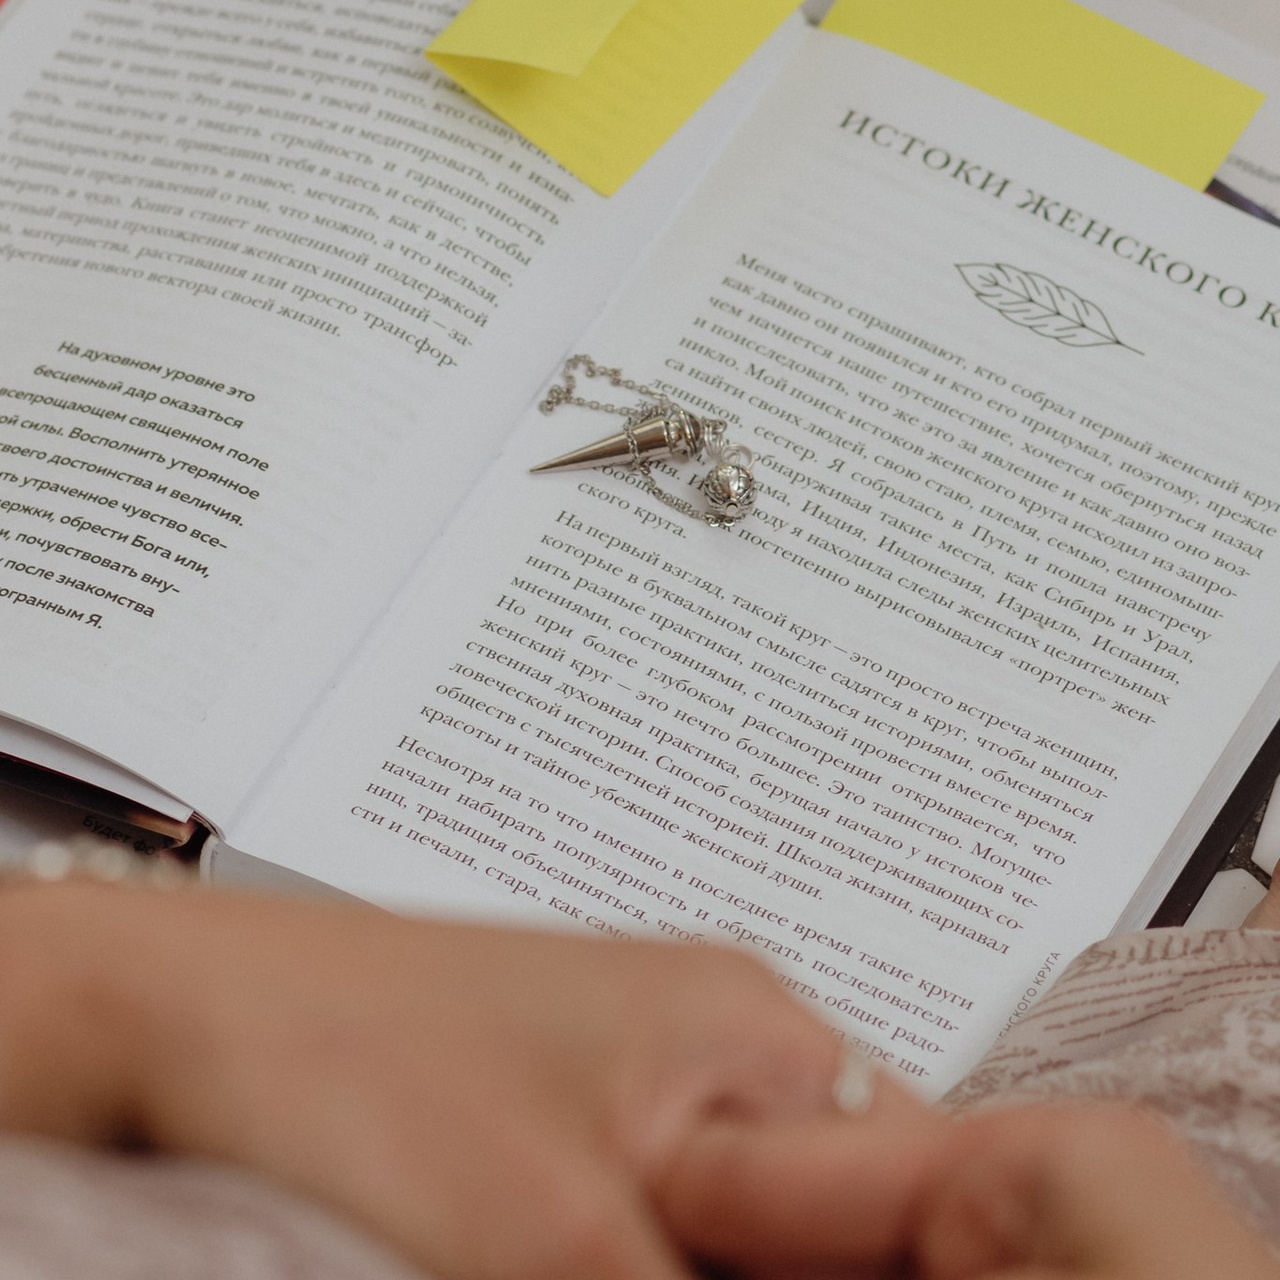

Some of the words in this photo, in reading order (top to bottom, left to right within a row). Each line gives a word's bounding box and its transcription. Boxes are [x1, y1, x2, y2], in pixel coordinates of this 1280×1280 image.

[838, 109, 1010, 199] ИСТОКИ
[1016, 188, 1249, 312] ЖЕНСКОГО
[33, 364, 123, 392] бесценный
[121, 386, 157, 402] дар
[158, 395, 244, 429] оказаться
[57, 340, 80, 355] На
[79, 348, 162, 373] духовном
[160, 367, 225, 392] уровне
[225, 386, 255, 402] это
[736, 252, 787, 284] Меня
[793, 280, 843, 309] часто
[847, 307, 966, 369] спрашивают,
[973, 365, 1006, 385] кто
[1010, 383, 1075, 419] собрал
[1079, 415, 1152, 454] первый
[1154, 450, 1239, 494] женский
[20, 419, 63, 436] силы.
[67, 426, 165, 463] Восполнить
[165, 457, 260, 500] утерянное
[128, 416, 225, 453] священном
[225, 447, 269, 471] поле
[664, 358, 684, 372] са
[687, 367, 745, 399] найти
[748, 395, 802, 426] своих
[802, 422, 866, 459] людей,
[873, 455, 921, 481] свою
[924, 478, 973, 509] стаю,
[979, 504, 1040, 541] племя,
[1046, 536, 1109, 573] семью,
[1116, 568, 1223, 618] единомыш-
[18, 476, 118, 508] утраченное
[121, 502, 187, 533] чувство
[189, 528, 227, 548] все-
[46, 454, 153, 489] достоинства
[154, 484, 168, 494] и
[168, 488, 243, 526] величия.
[577, 482, 630, 509] ского
[633, 506, 686, 538] круга.
[4, 559, 54, 580] после
[55, 574, 154, 618] знакомства
[14, 532, 138, 577] почувствовать
[139, 572, 180, 593] вну-
[59, 515, 129, 542] обрести
[130, 534, 171, 559] Бога
[173, 553, 209, 578] или,
[880, 511, 932, 542] такие
[937, 540, 994, 575] места,
[1003, 571, 1037, 592] как
[1044, 586, 1115, 627] Сибирь
[1122, 624, 1137, 636] и
[1142, 629, 1192, 664] Урал,
[84, 613, 103, 629] Я.
[540, 534, 623, 576] которые
[626, 573, 638, 584] в
[643, 579, 752, 638] буквальном
[756, 636, 826, 674] смысле
[830, 672, 902, 710] садятся
[905, 706, 918, 717] в
[922, 713, 966, 742] круг,
[976, 736, 1036, 769] чтобы
[1039, 765, 1107, 799] выпол-
[555, 510, 582, 531] На
[585, 526, 660, 565] первый
[661, 561, 724, 600] взгляд,
[732, 594, 787, 627] такой
[788, 622, 831, 646] круг
[849, 651, 882, 672] это
[885, 668, 953, 705] просто
[955, 700, 1030, 740] встреча
[1032, 734, 1117, 780] женщин,
[735, 521, 849, 586] постепенно
[854, 583, 1003, 659] вырисовывался
[1009, 657, 1105, 702] «портрет»
[1110, 700, 1155, 724] жен-
[466, 641, 553, 684] ственная
[554, 681, 643, 728] духовная
[647, 725, 739, 779] практика,
[749, 773, 830, 818] берущая
[835, 814, 902, 849] начало
[905, 845, 921, 859] у
[924, 853, 1003, 894] истоков
[1011, 890, 1037, 907] че-
[495, 594, 525, 615] Но
[534, 614, 574, 637] при
[582, 634, 637, 667] более
[646, 667, 734, 715] глубоком
[740, 714, 882, 784] рассмотрении
[891, 783, 1017, 846] открывается,
[1033, 843, 1065, 865] что
[419, 705, 501, 747] красоты
[503, 742, 519, 755] и
[523, 750, 590, 789] тайное
[589, 785, 679, 833] убежище
[681, 829, 767, 874] женской
[766, 870, 822, 900] души.
[448, 663, 561, 717] ловеческой
[563, 713, 647, 761] истории.
[655, 755, 729, 797] Способ
[729, 794, 817, 840] создания
[819, 835, 993, 918] поддерживающих
[995, 914, 1023, 929] со-
[380, 760, 450, 796] начали
[456, 793, 545, 841] набирать
[552, 839, 686, 910] популярность
[693, 908, 710, 921] и
[716, 918, 803, 962] обретать
[811, 960, 958, 1030] последователь-
[396, 734, 494, 787] Несмотря
[497, 783, 521, 801] на
[527, 796, 549, 813] то
[556, 810, 588, 832] что
[592, 829, 667, 871] именно
[670, 867, 683, 879] в
[687, 875, 788, 926] последнее
[792, 923, 853, 955] время
[859, 951, 913, 982] такие
[917, 979, 973, 1010] круги
[824, 994, 889, 1030] общие
[891, 1027, 945, 1054] радо-
[994, 987, 1037, 1044] НСКОГО
[1033, 952, 1061, 985] КРУГА
[898, 1058, 930, 1078] ци-
